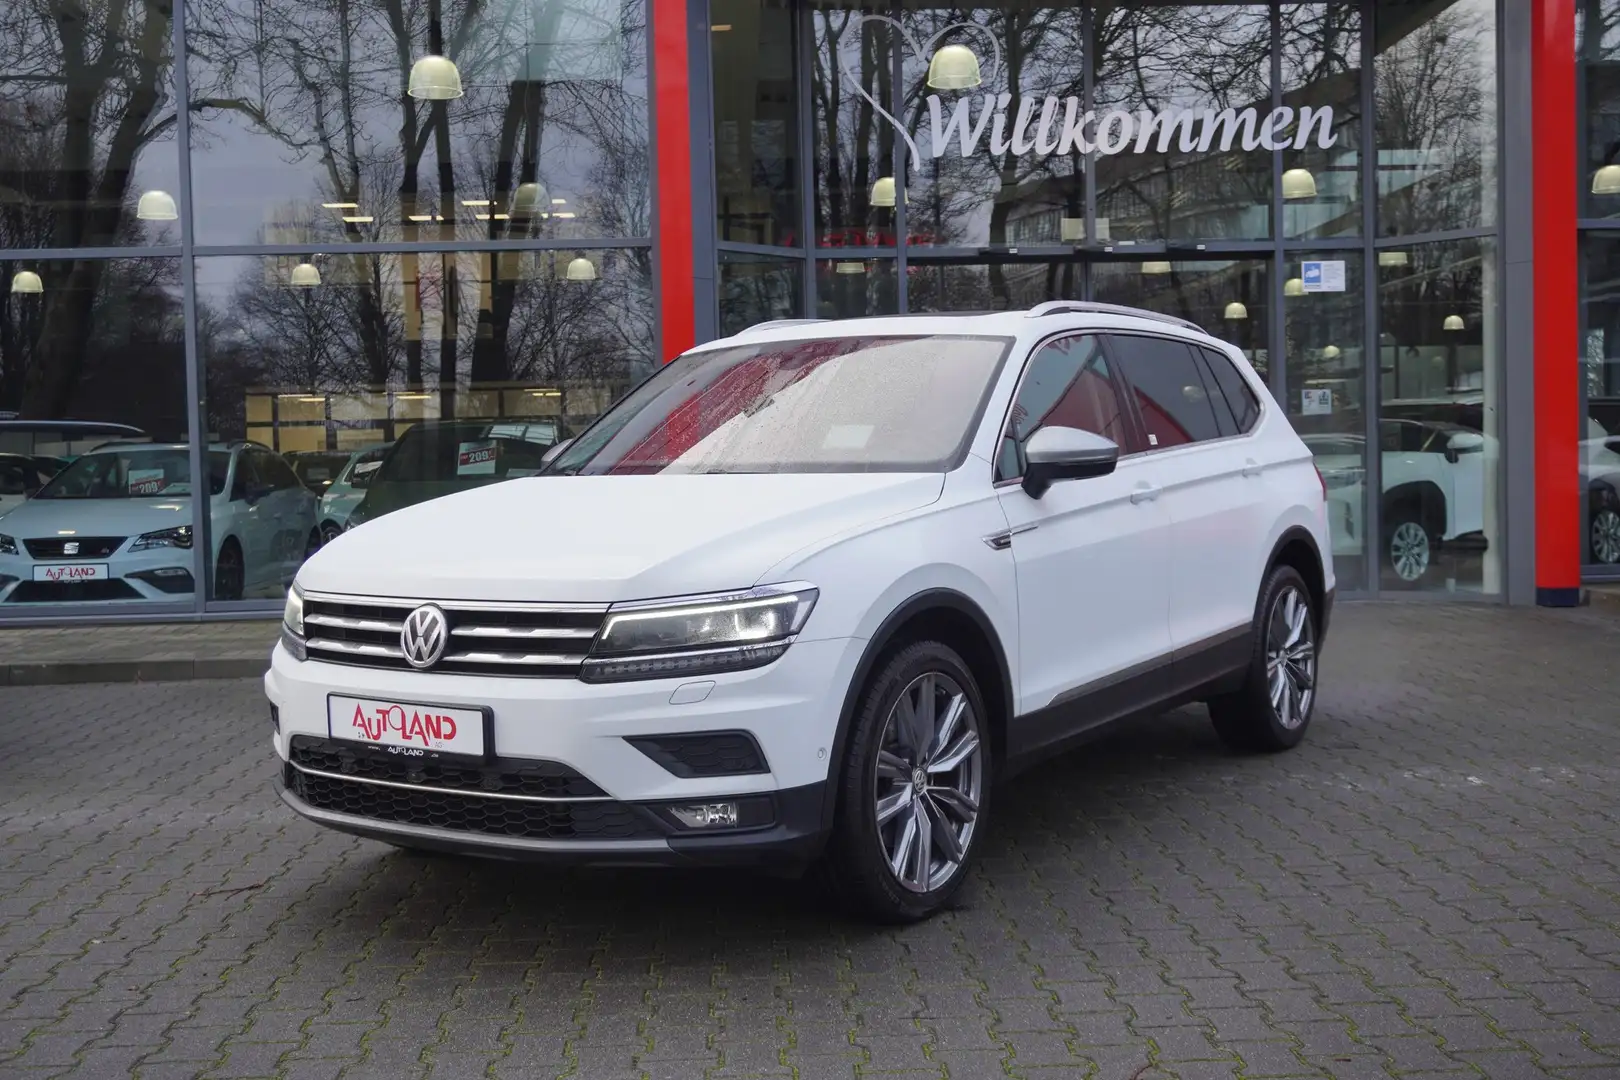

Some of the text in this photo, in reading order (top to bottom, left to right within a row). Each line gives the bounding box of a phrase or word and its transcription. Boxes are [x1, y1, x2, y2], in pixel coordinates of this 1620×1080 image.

[926, 93, 1338, 157] Willkommen
[45, 566, 96, 583] AUTOLAND
[352, 702, 457, 746] AUTOLAND
[387, 746, 424, 757] AUTOLAND
